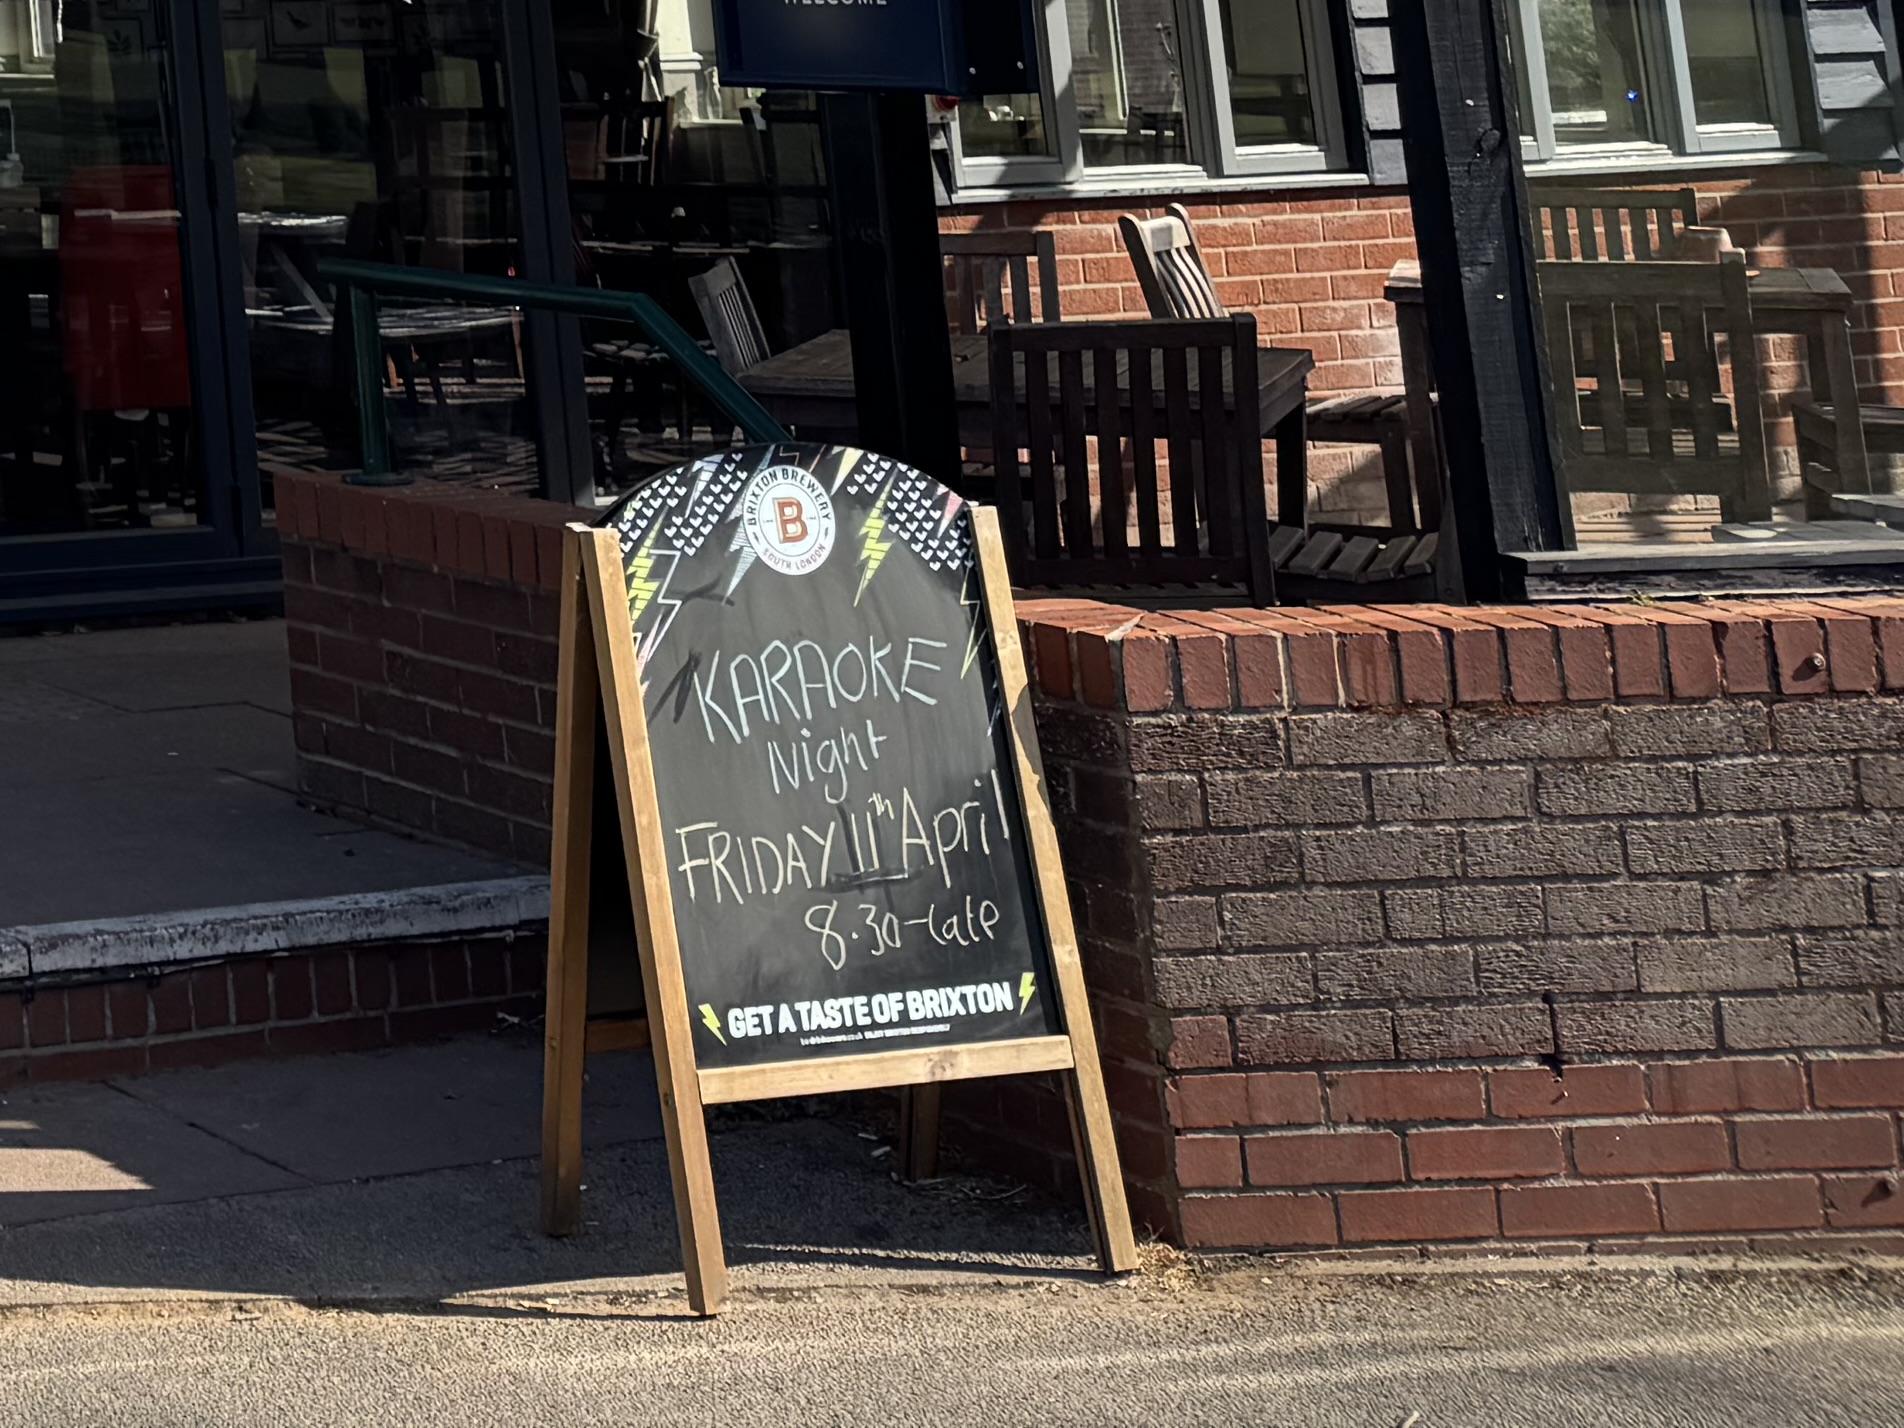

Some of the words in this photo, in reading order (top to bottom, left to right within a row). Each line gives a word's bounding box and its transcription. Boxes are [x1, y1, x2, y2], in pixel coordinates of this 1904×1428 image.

[747, 469, 779, 526] BRIXTON
[781, 467, 832, 521] BREWERY
[772, 496, 809, 545] B
[763, 547, 792, 570] SOUTH
[795, 543, 827, 571] LONDON
[693, 635, 948, 745] KARAOKE
[767, 719, 888, 804] Night
[675, 821, 836, 905] FRIDAY
[903, 768, 1009, 889] April
[727, 1003, 774, 1039] GET
[777, 1003, 797, 1034] A
[795, 995, 872, 1032] TASTE
[872, 992, 905, 1024] OF
[905, 981, 1015, 1021] BRIXTON
